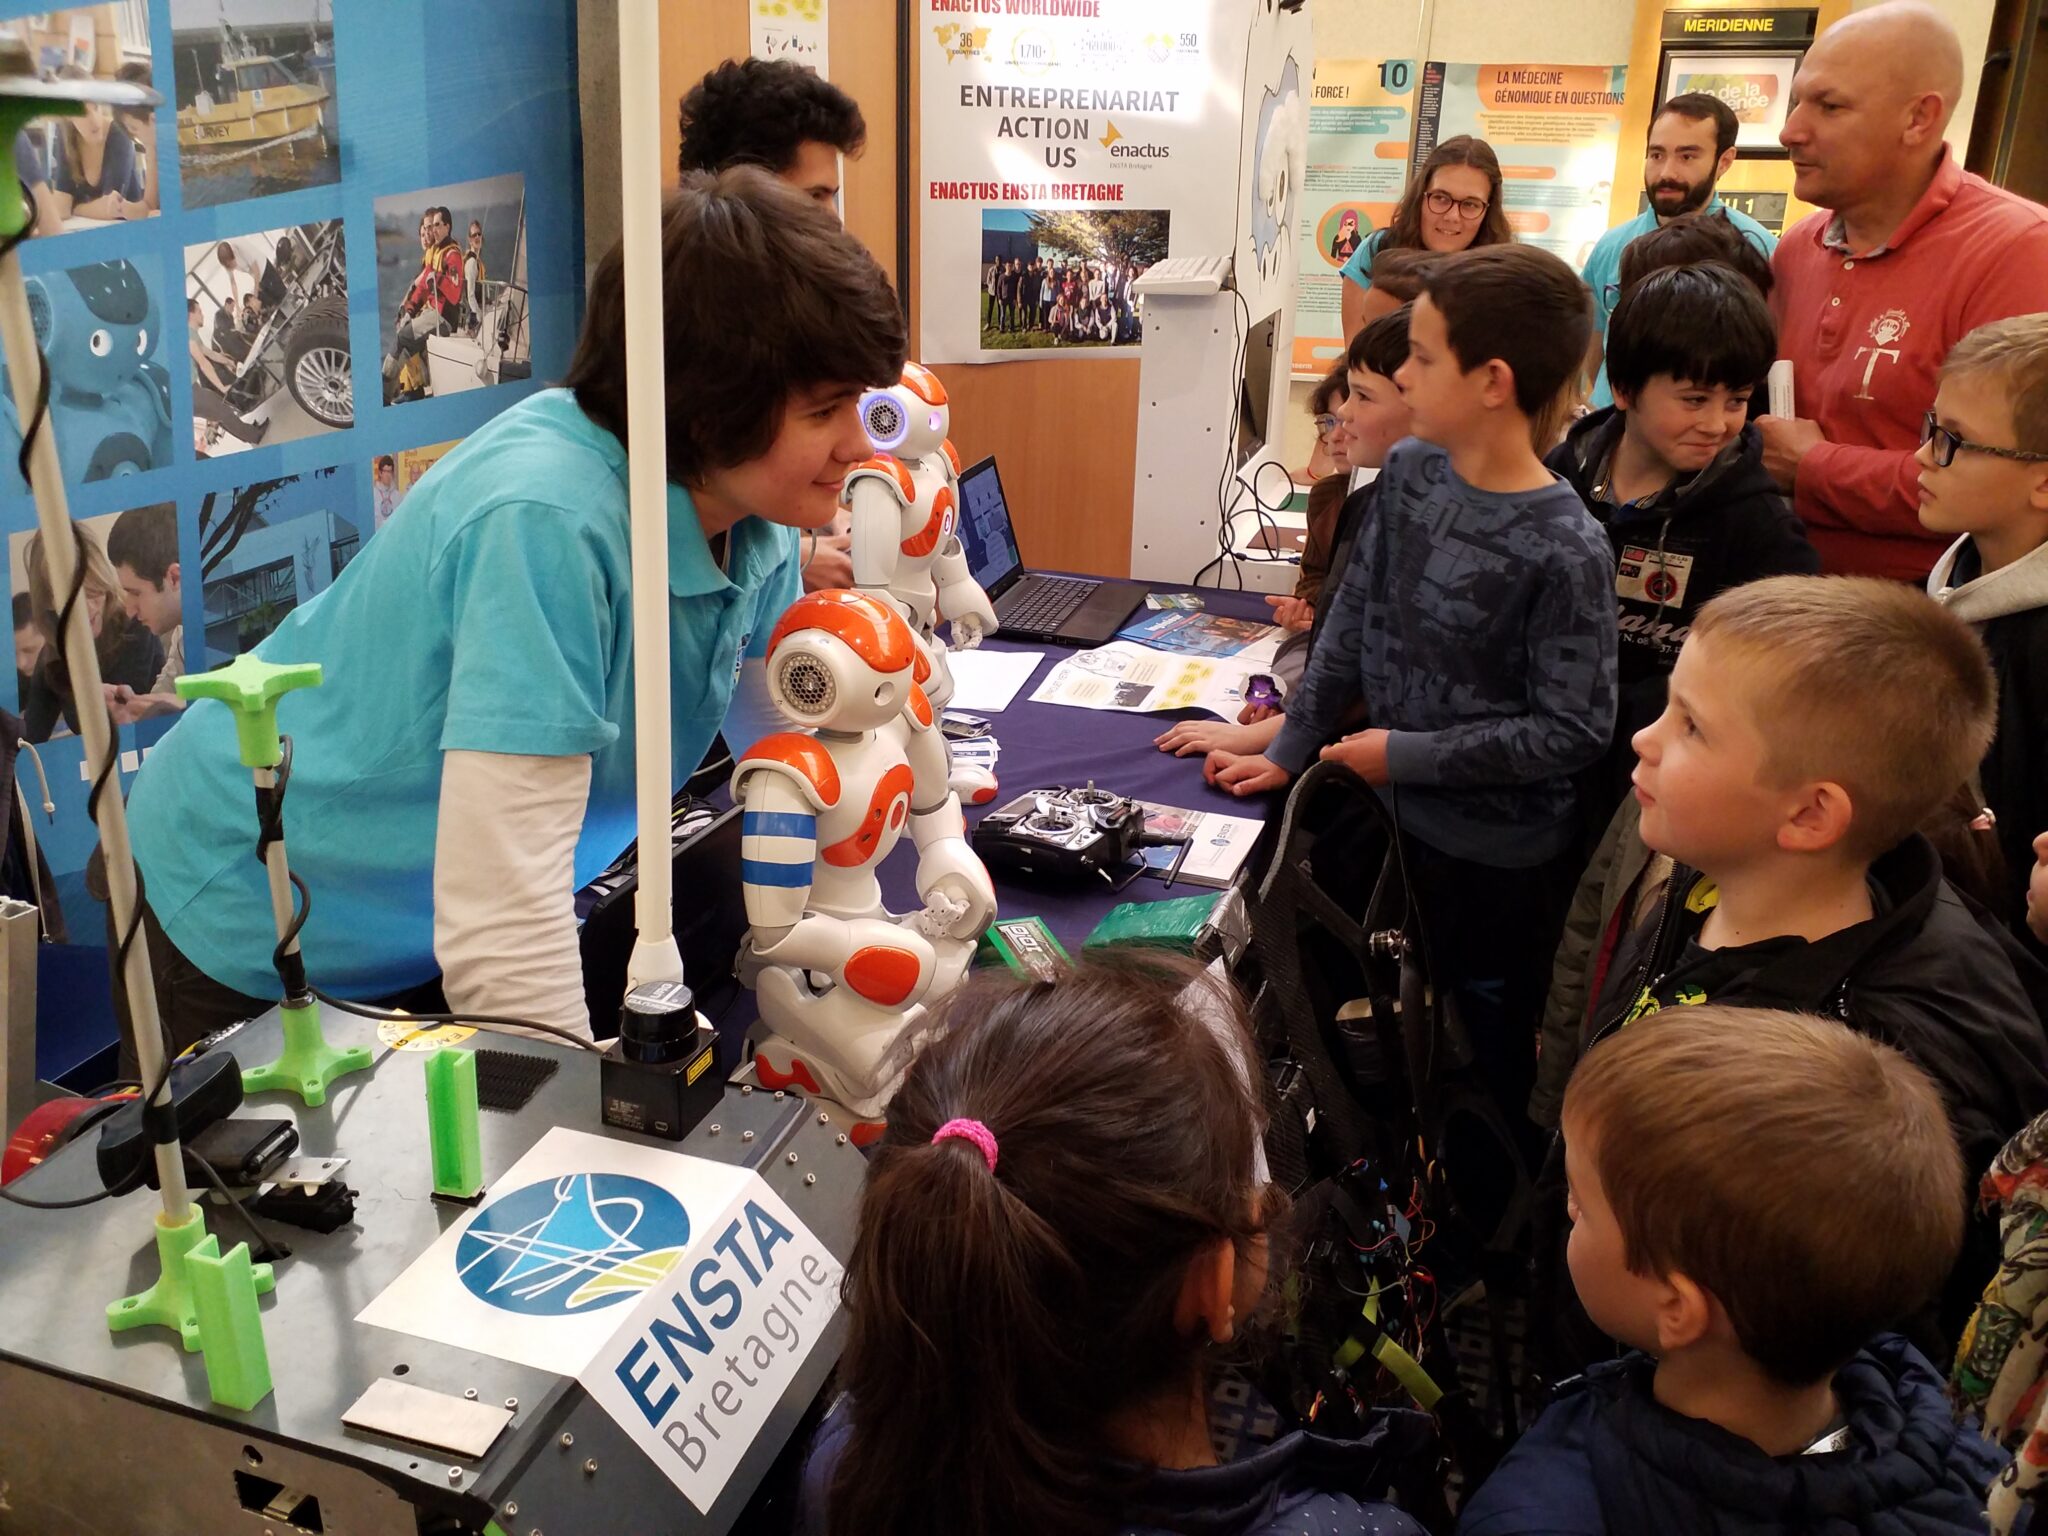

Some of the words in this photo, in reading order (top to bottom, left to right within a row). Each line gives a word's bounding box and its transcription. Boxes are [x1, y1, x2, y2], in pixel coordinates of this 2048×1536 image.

[930, 0, 1001, 13] ENACTUS
[1004, 0, 1101, 18] WORLDWIDE
[1684, 18, 1775, 33] MERIDIENNE
[959, 32, 973, 48] 36
[1179, 32, 1198, 48] 550
[1377, 63, 1408, 88] 10
[1497, 71, 1510, 84] LA
[1511, 68, 1564, 85] MÉDECINE
[959, 84, 1180, 112] ENTREPRENARIAT
[1315, 86, 1345, 99] FORCE
[1494, 88, 1552, 104] GÉNOMIQUE
[1554, 90, 1567, 104] EN
[1570, 91, 1626, 106] QUESTIONS
[1718, 83, 1743, 100] de
[1745, 81, 1760, 96] la
[1723, 94, 1769, 111] ence
[997, 116, 1089, 140] ACTION
[1045, 146, 1077, 168] US
[1110, 143, 1170, 159] enactus
[929, 181, 999, 200] ENACTUS
[1001, 182, 1047, 200] ENSTA
[1051, 183, 1125, 201] BRETAGNE
[614, 1199, 795, 1429] ENSTA
[662, 1253, 828, 1474] Bretagne
